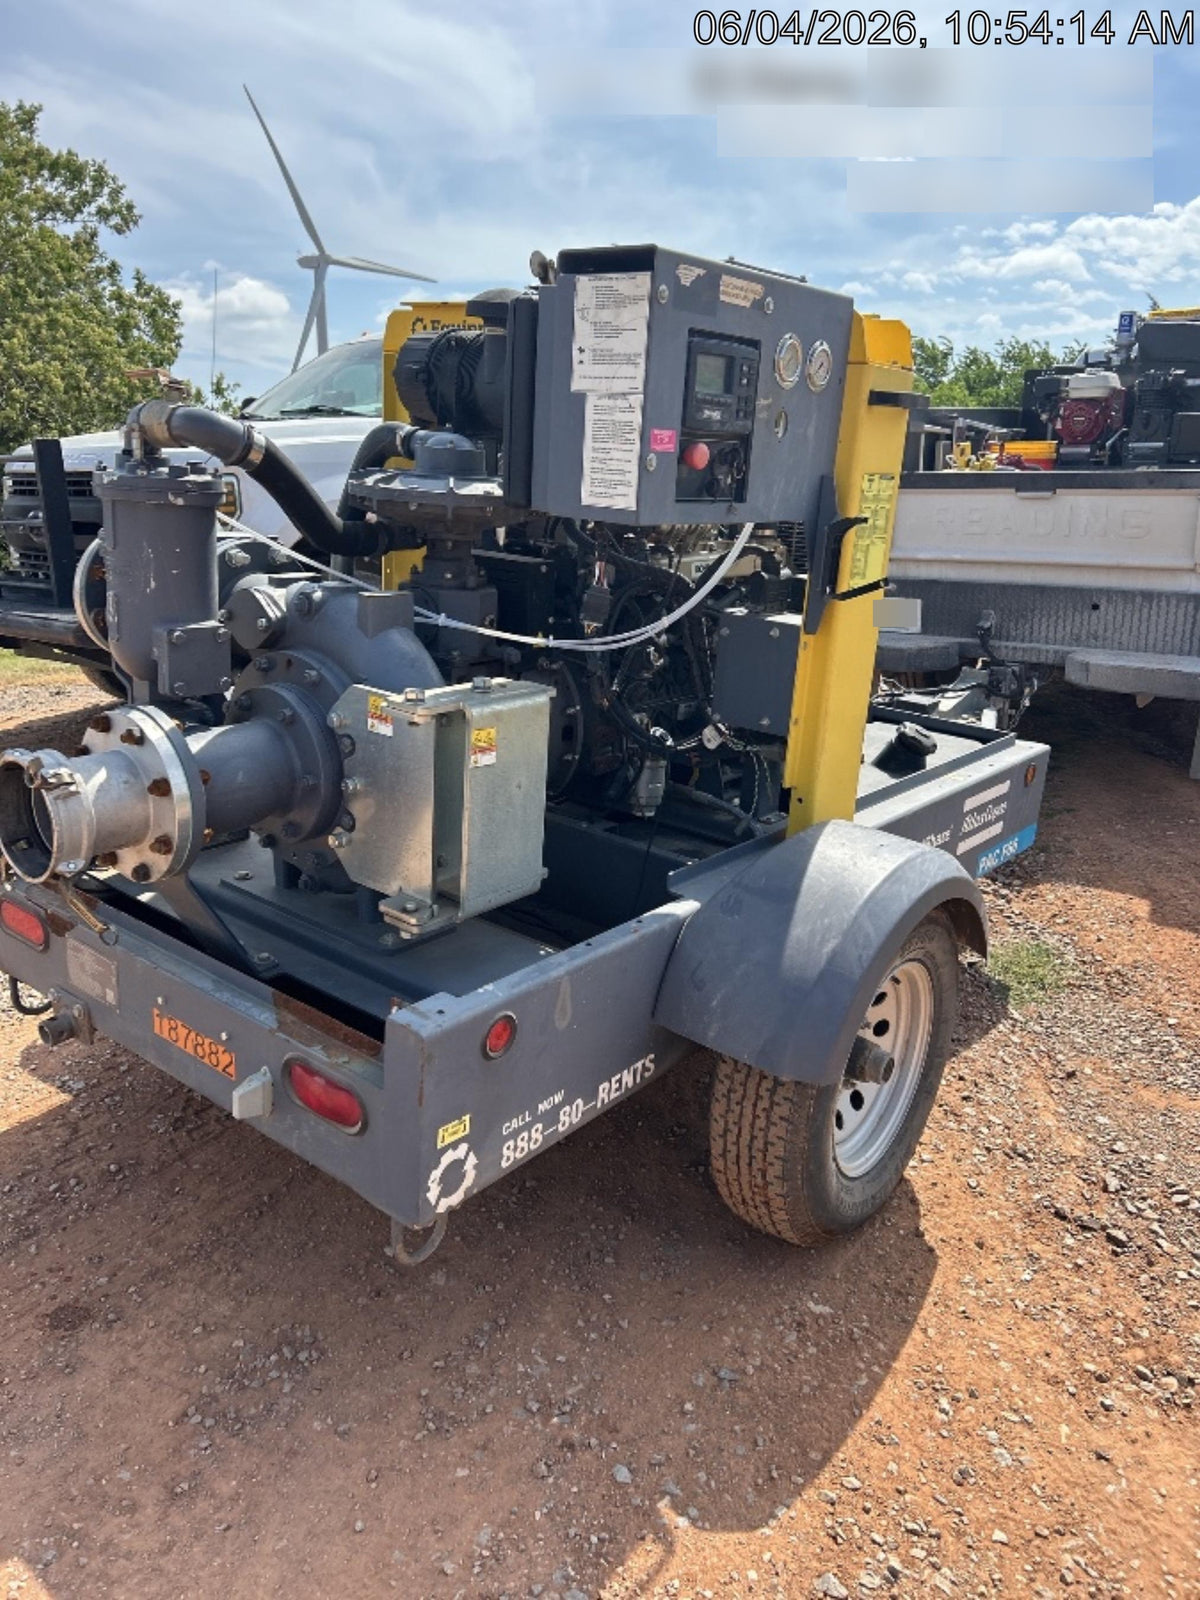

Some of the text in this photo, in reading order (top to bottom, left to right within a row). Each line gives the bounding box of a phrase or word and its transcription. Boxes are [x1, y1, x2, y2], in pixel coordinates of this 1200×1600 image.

[935, 503, 1153, 540] READING
[155, 1012, 234, 1078] 187882
[502, 1089, 565, 1135] CALL NOW
